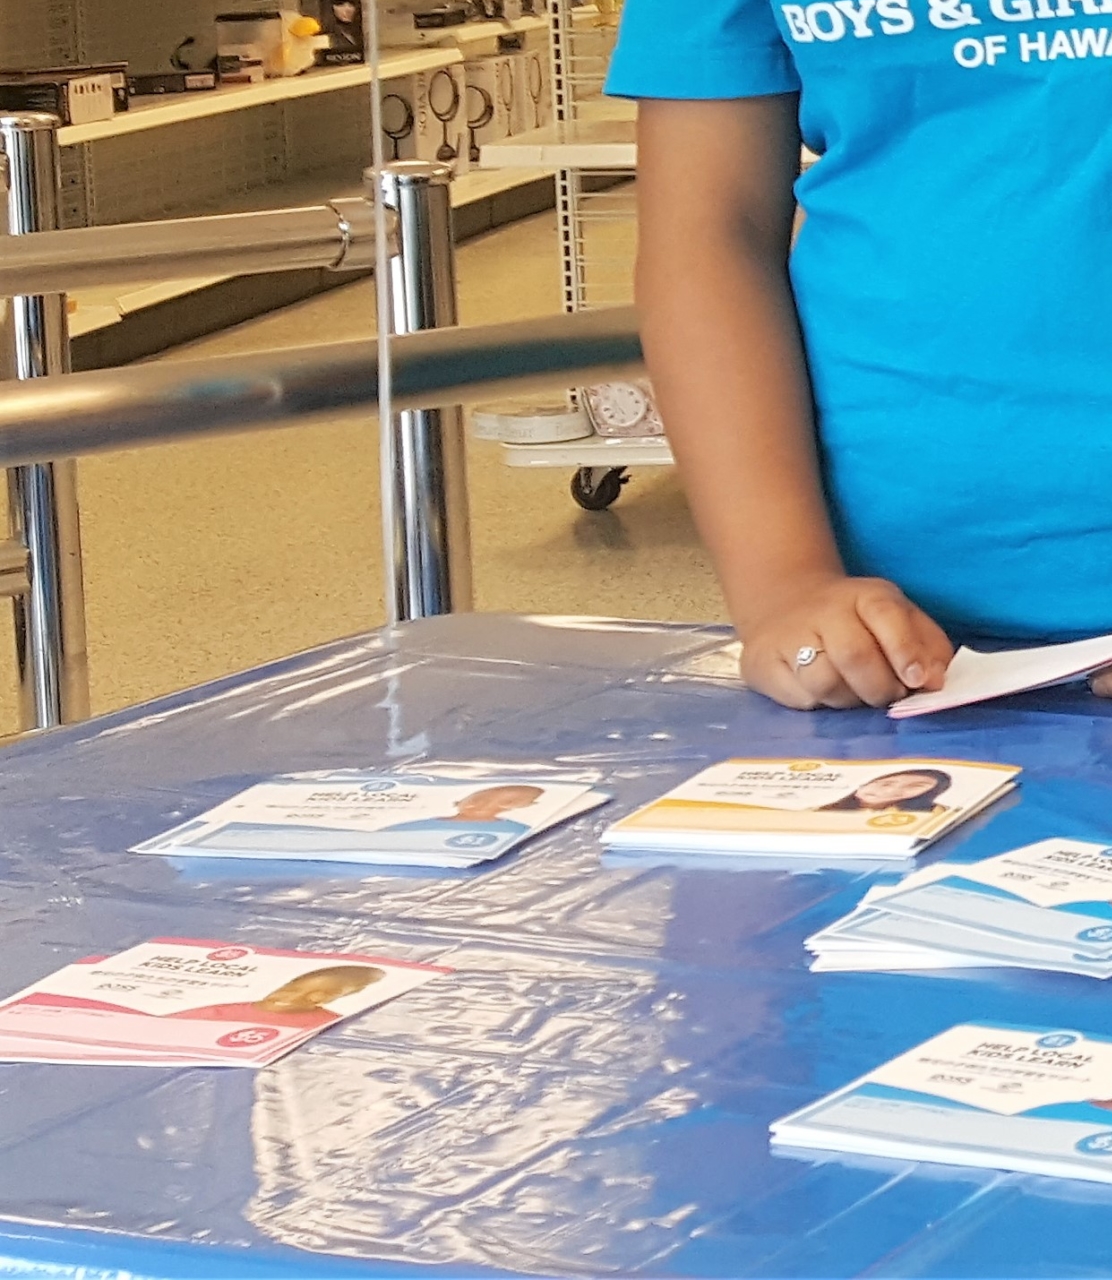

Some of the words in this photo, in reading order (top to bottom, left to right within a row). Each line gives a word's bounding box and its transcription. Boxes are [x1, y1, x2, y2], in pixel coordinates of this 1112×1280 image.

[953, 35, 1007, 68] OF
[138, 961, 184, 971] KIDS
[184, 966, 248, 978] LEARN
[150, 955, 200, 965] HELP
[200, 961, 258, 973] LOCAL
[976, 1041, 1030, 1053] HELP
[1030, 1047, 1094, 1063] LOCAL
